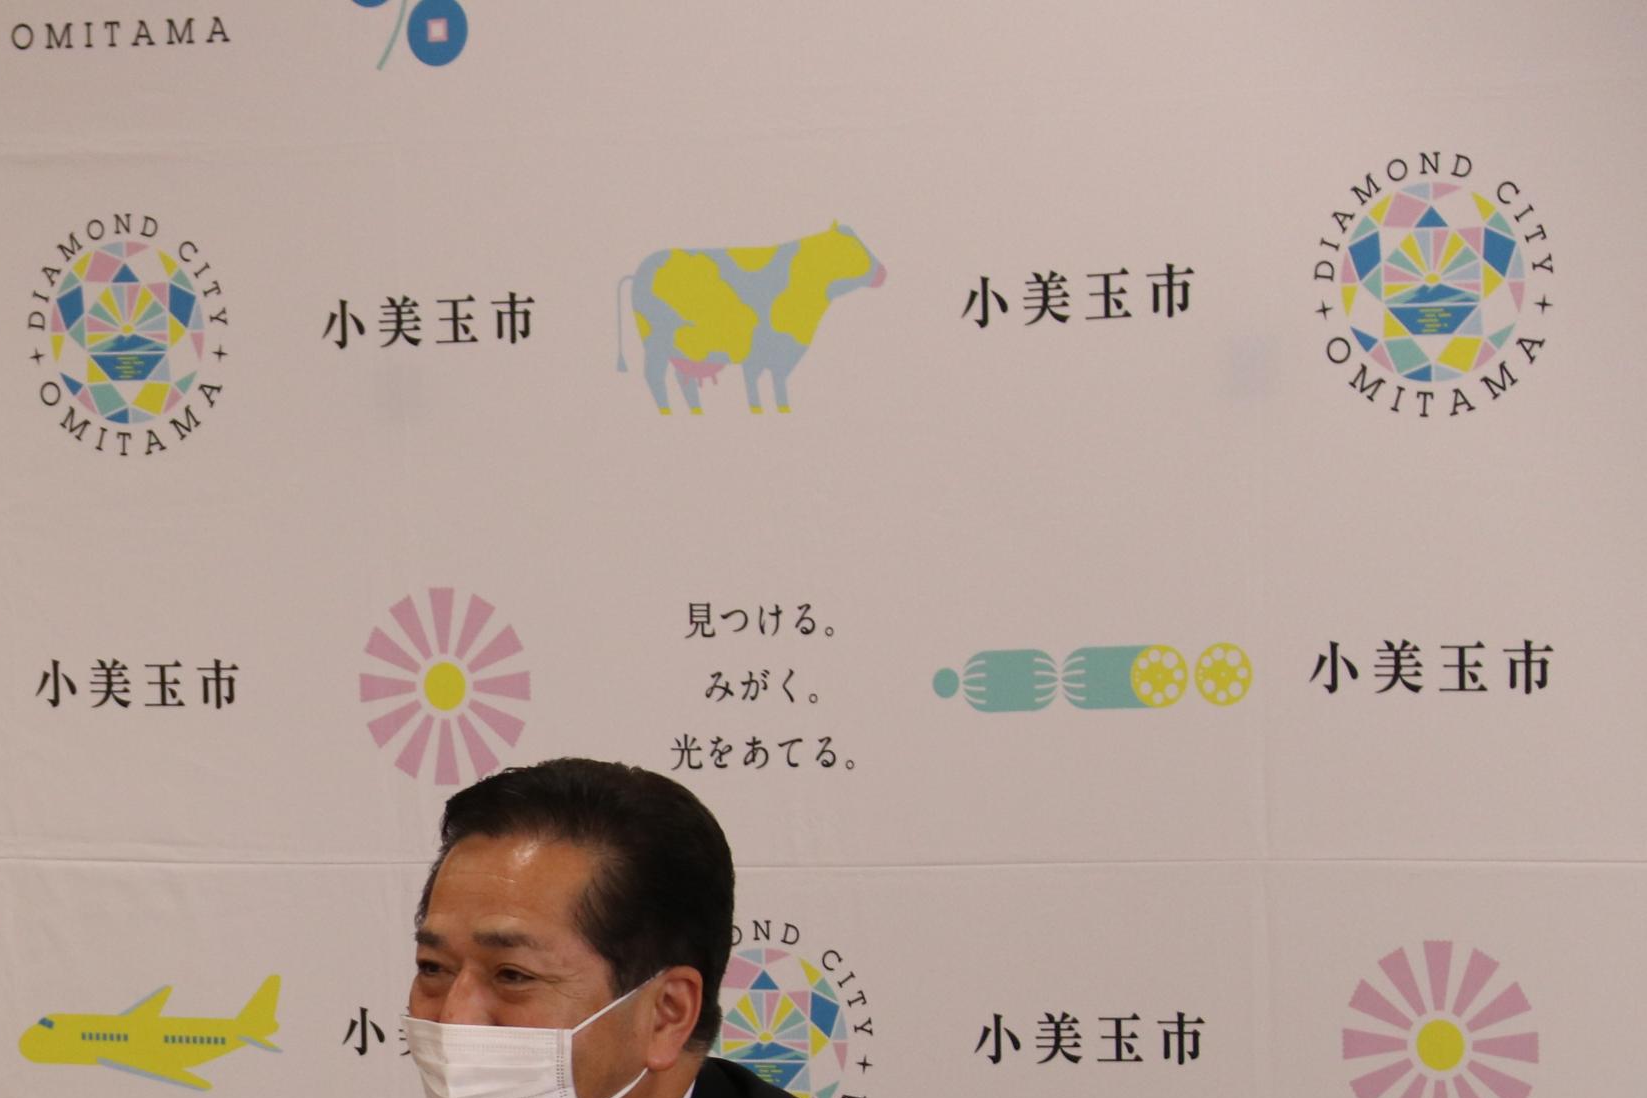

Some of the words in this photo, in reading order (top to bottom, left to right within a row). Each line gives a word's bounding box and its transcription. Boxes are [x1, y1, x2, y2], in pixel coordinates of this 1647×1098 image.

[11, 17, 230, 50] OMITAMA
[1313, 151, 1474, 283] DIAMOND
[1495, 180, 1556, 275] CITY
[27, 212, 160, 331] DIAMOND
[178, 240, 229, 327] CITY
[963, 264, 1194, 328] 小美玉市
[323, 292, 534, 349] 小美玉市
[1325, 334, 1546, 418] OMITAMA
[39, 380, 223, 457] OMITAMA
[686, 603, 833, 638] 見つける。
[37, 659, 238, 709] 小美玉市
[706, 669, 817, 703] みがく。
[1310, 640, 1553, 694] 小美玉市
[671, 734, 854, 770] 光をあてる。
[821, 948, 874, 1037] CITY
[975, 1012, 1205, 1065] 小美玉市
